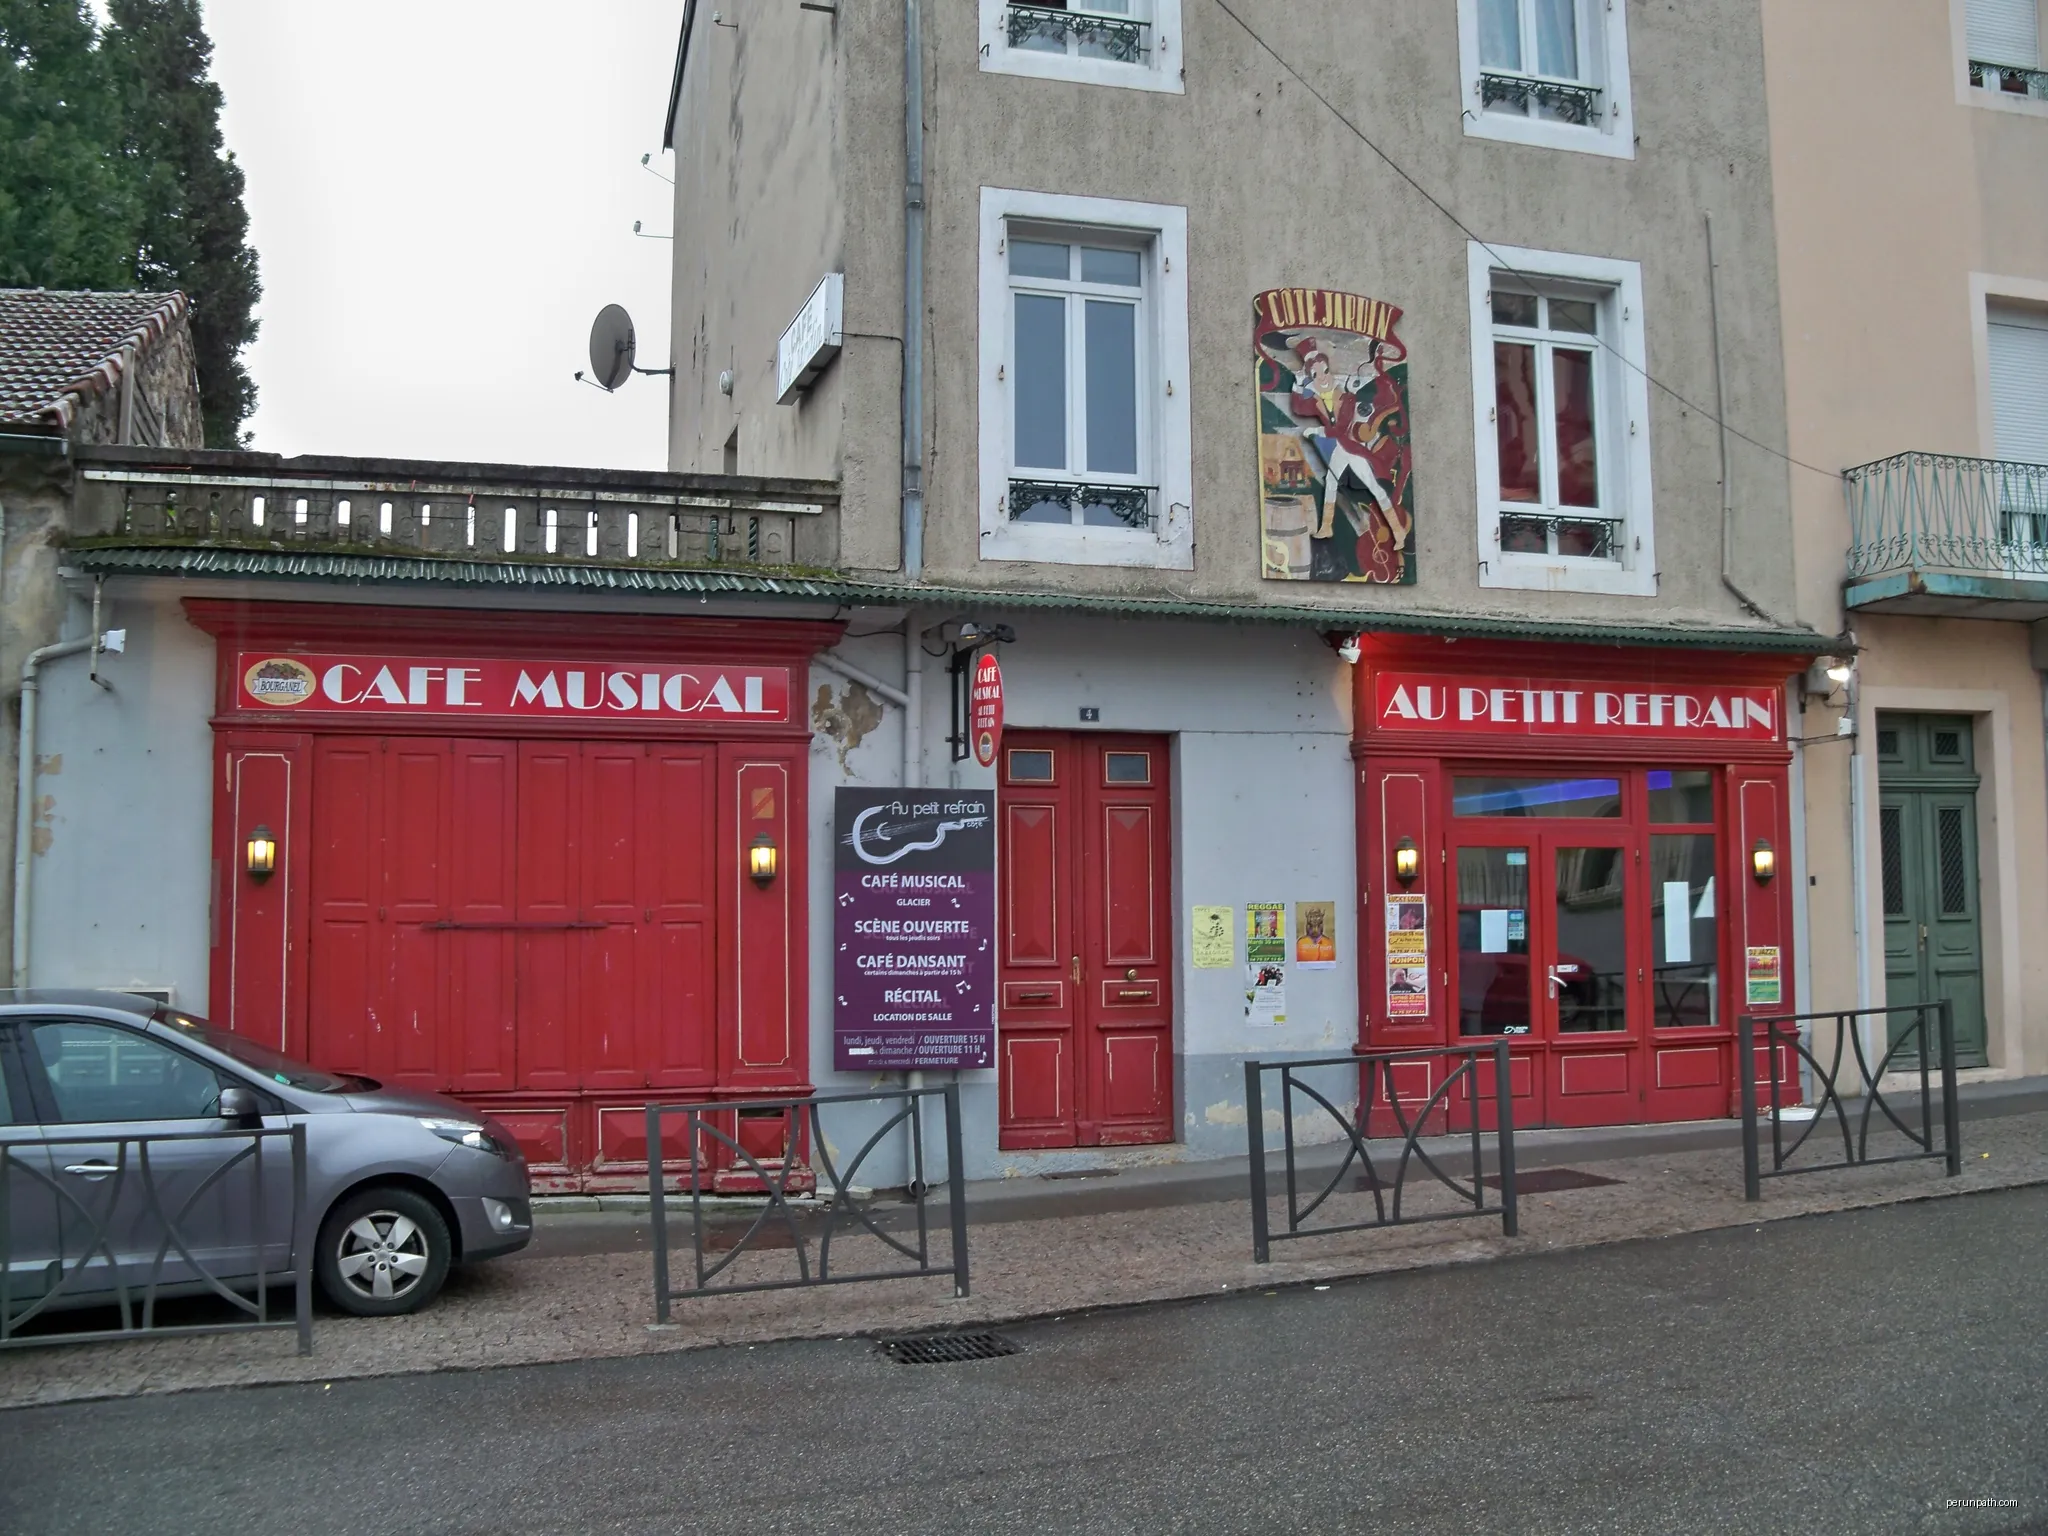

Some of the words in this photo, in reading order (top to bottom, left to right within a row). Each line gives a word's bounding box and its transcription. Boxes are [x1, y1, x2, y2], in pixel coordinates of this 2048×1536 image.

[977, 666, 997, 683] CAFE
[260, 680, 302, 692] BOURGANEL
[322, 664, 483, 706] CAFE
[510, 669, 780, 714] MUSICAL
[973, 685, 1001, 700] MUSICAL
[1383, 683, 1446, 721] AU
[1459, 687, 1584, 724] PETIT
[1594, 692, 1771, 731] REFRAIN
[1085, 708, 1093, 720] 4
[891, 801, 908, 815] Au
[913, 801, 940, 818] petit
[944, 800, 985, 815] refrain
[861, 872, 898, 888] CAFÉ
[901, 875, 966, 888] MUSICAL
[896, 898, 931, 907] GLACIER
[1248, 903, 1284, 911] REGGAE
[854, 918, 900, 933] SCÈNE
[903, 920, 969, 933] OUVERTE
[856, 952, 894, 968] CAFÉ
[896, 955, 967, 968] DANSANT
[1390, 956, 1424, 964] PONPON
[884, 987, 942, 1003] RÉCITAL
[873, 1013, 915, 1022] LOCATION
[915, 1013, 927, 1021] DE
[927, 1013, 953, 1021] SALLE
[843, 1035, 864, 1046] lundi,
[864, 1035, 884, 1046] jeudi,
[885, 1035, 915, 1045] vendredi
[924, 1034, 968, 1044] OUVERTURE
[969, 1034, 978, 1043] 15
[979, 1034, 986, 1043] H
[879, 1045, 913, 1055] dimanche
[918, 1044, 963, 1054] OUVERTURE
[964, 1044, 973, 1053] 11
[974, 1044, 981, 1053] H
[914, 1056, 959, 1065] FERMETURE
